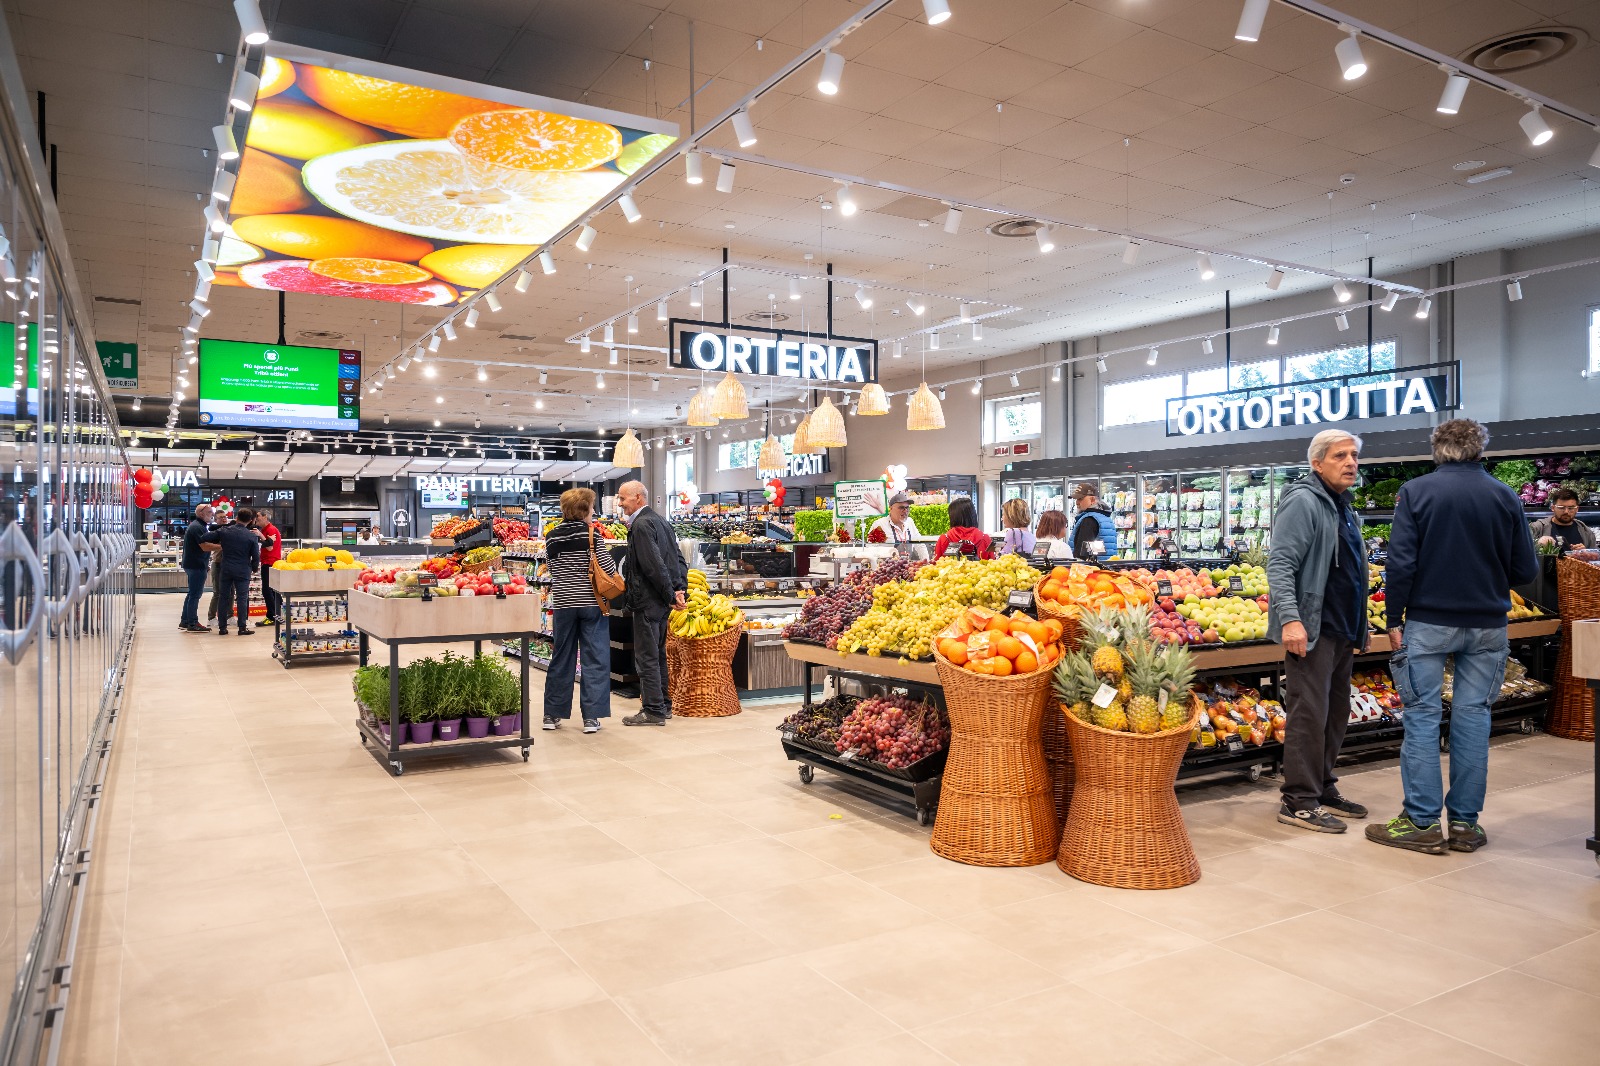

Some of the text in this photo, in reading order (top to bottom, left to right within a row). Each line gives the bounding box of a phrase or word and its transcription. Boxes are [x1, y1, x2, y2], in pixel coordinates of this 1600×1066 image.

[690, 332, 866, 383] ORTERIA
[1177, 377, 1437, 436] ORTOFRUTTA
[416, 476, 533, 493] PANETTERIA
